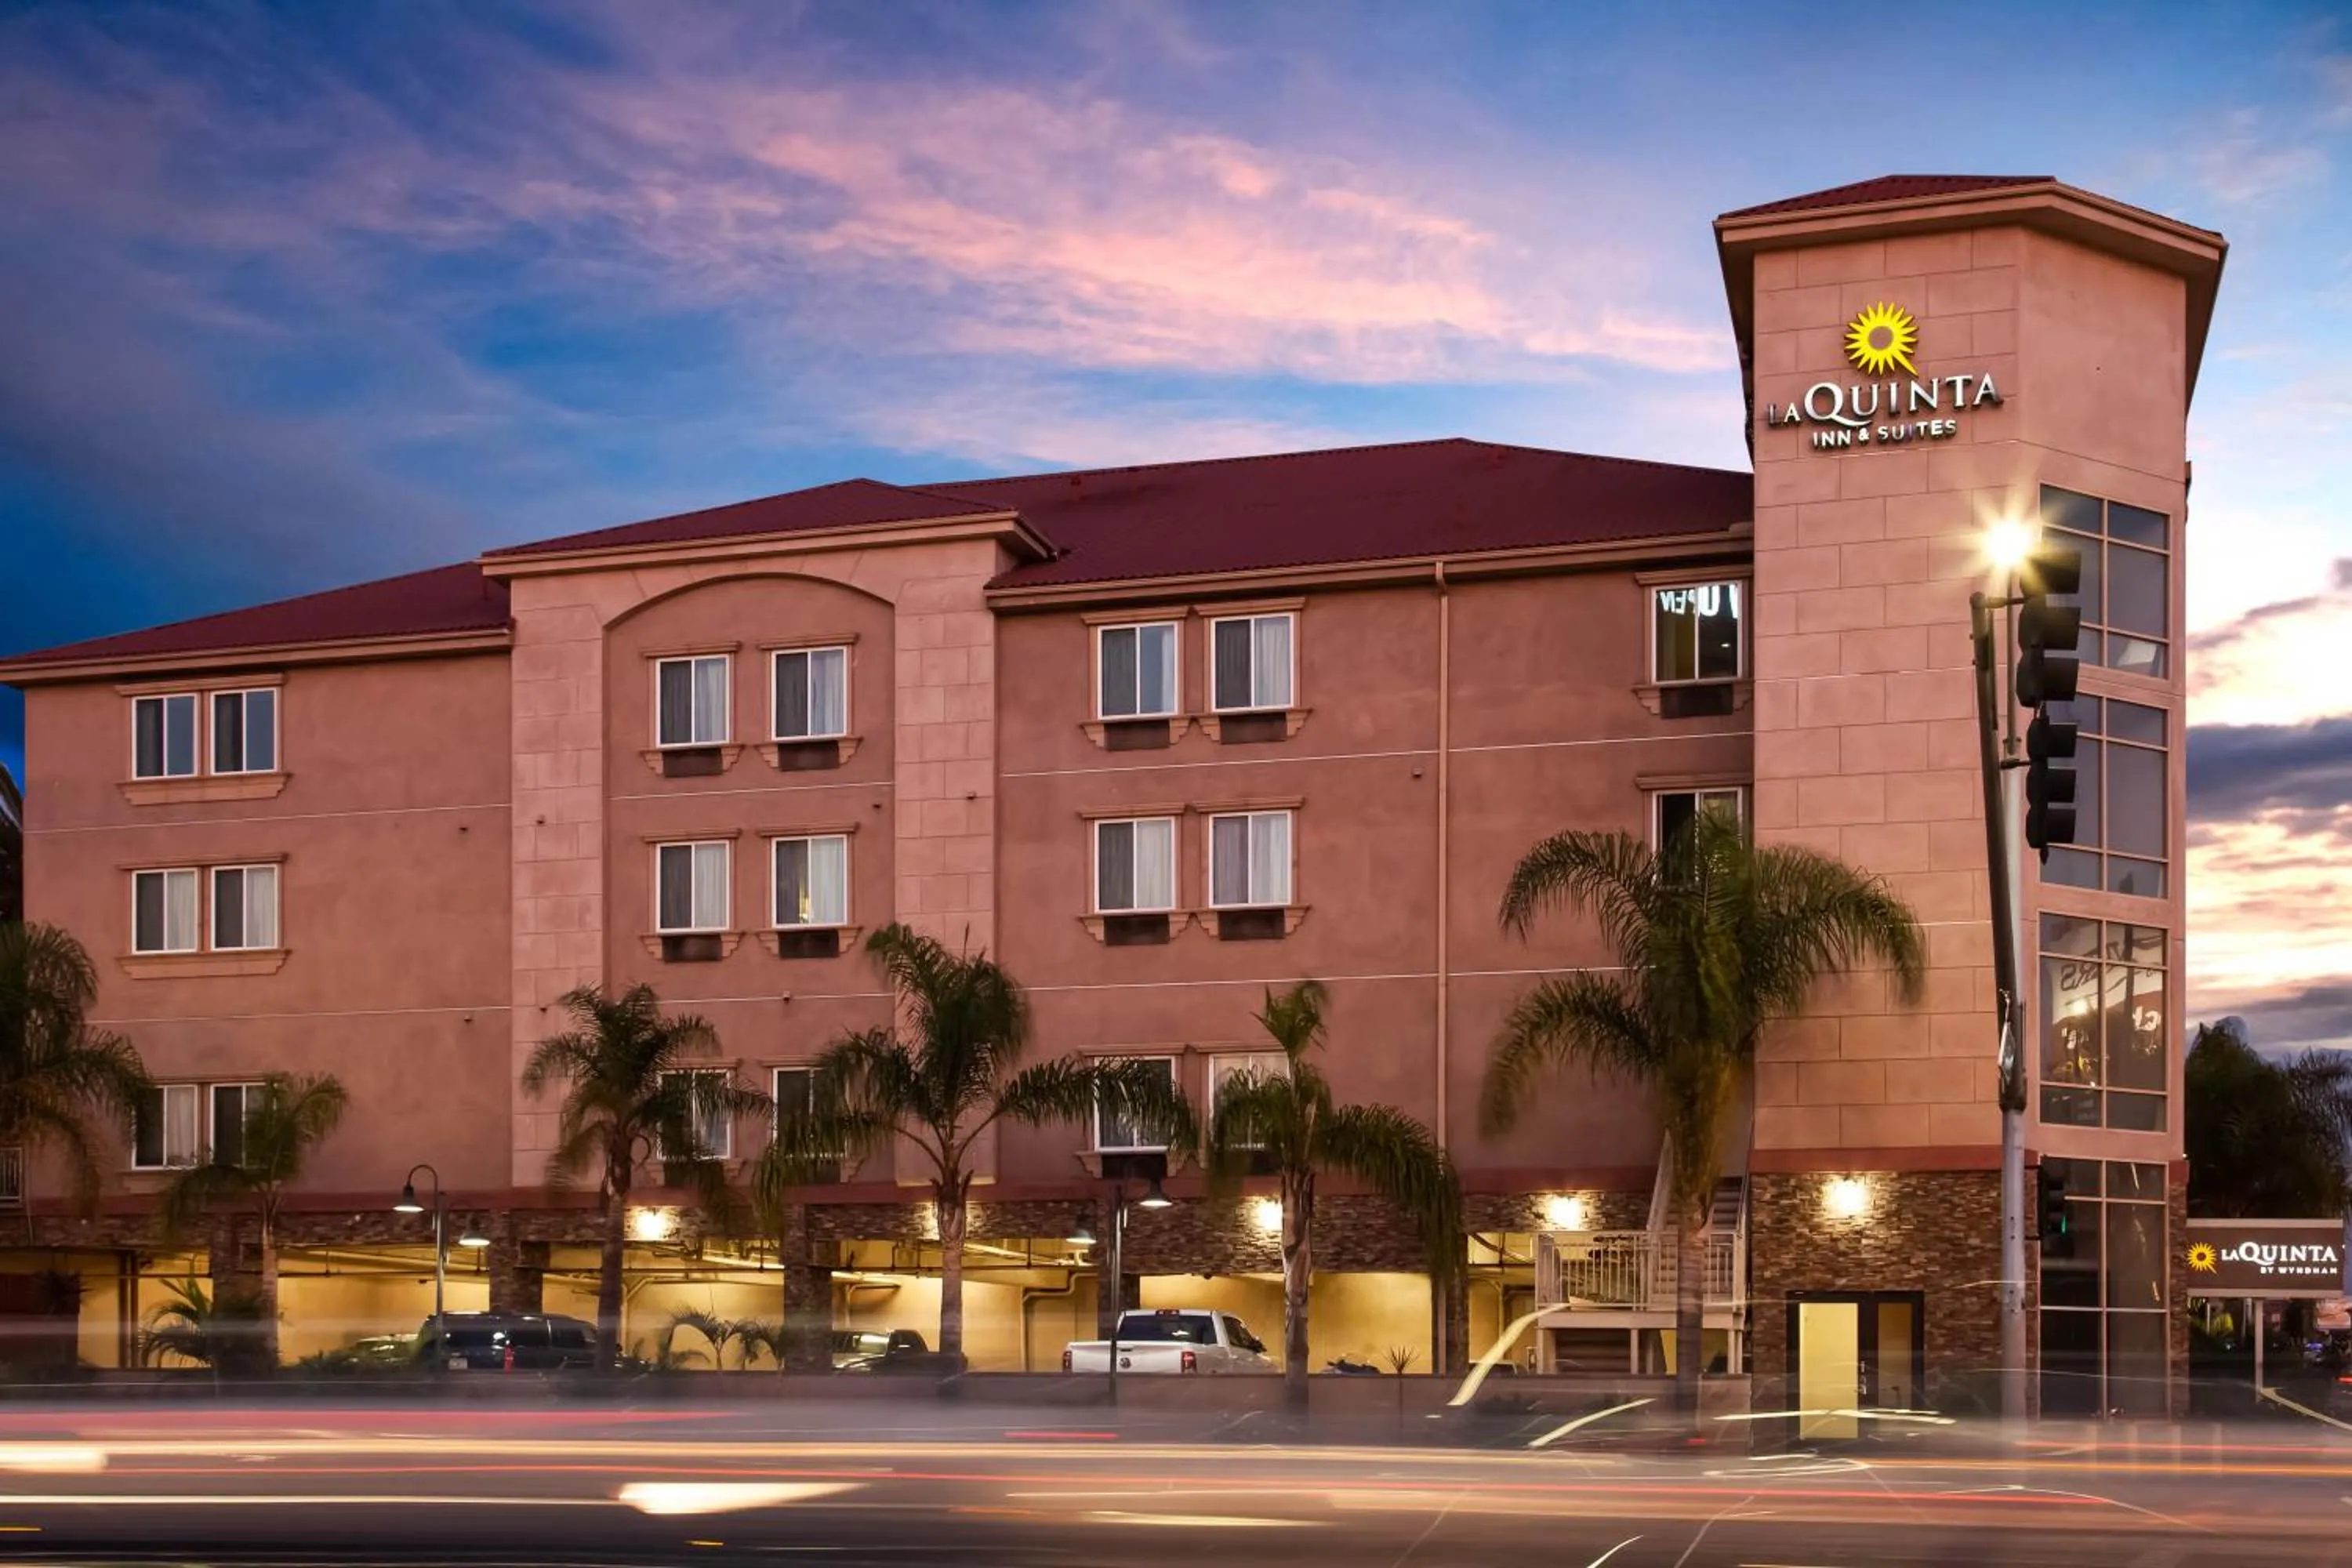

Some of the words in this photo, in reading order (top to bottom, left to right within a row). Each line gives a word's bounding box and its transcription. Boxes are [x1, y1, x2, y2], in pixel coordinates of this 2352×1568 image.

[1767, 402, 1801, 426] LA
[1804, 372, 2003, 426] QUINTA
[1813, 428, 1851, 448] INN
[1858, 427, 1870, 442] &
[1878, 419, 1957, 442] SUITES
[2221, 1249, 2239, 1261] LA
[2239, 1241, 2338, 1265] QUINTA
